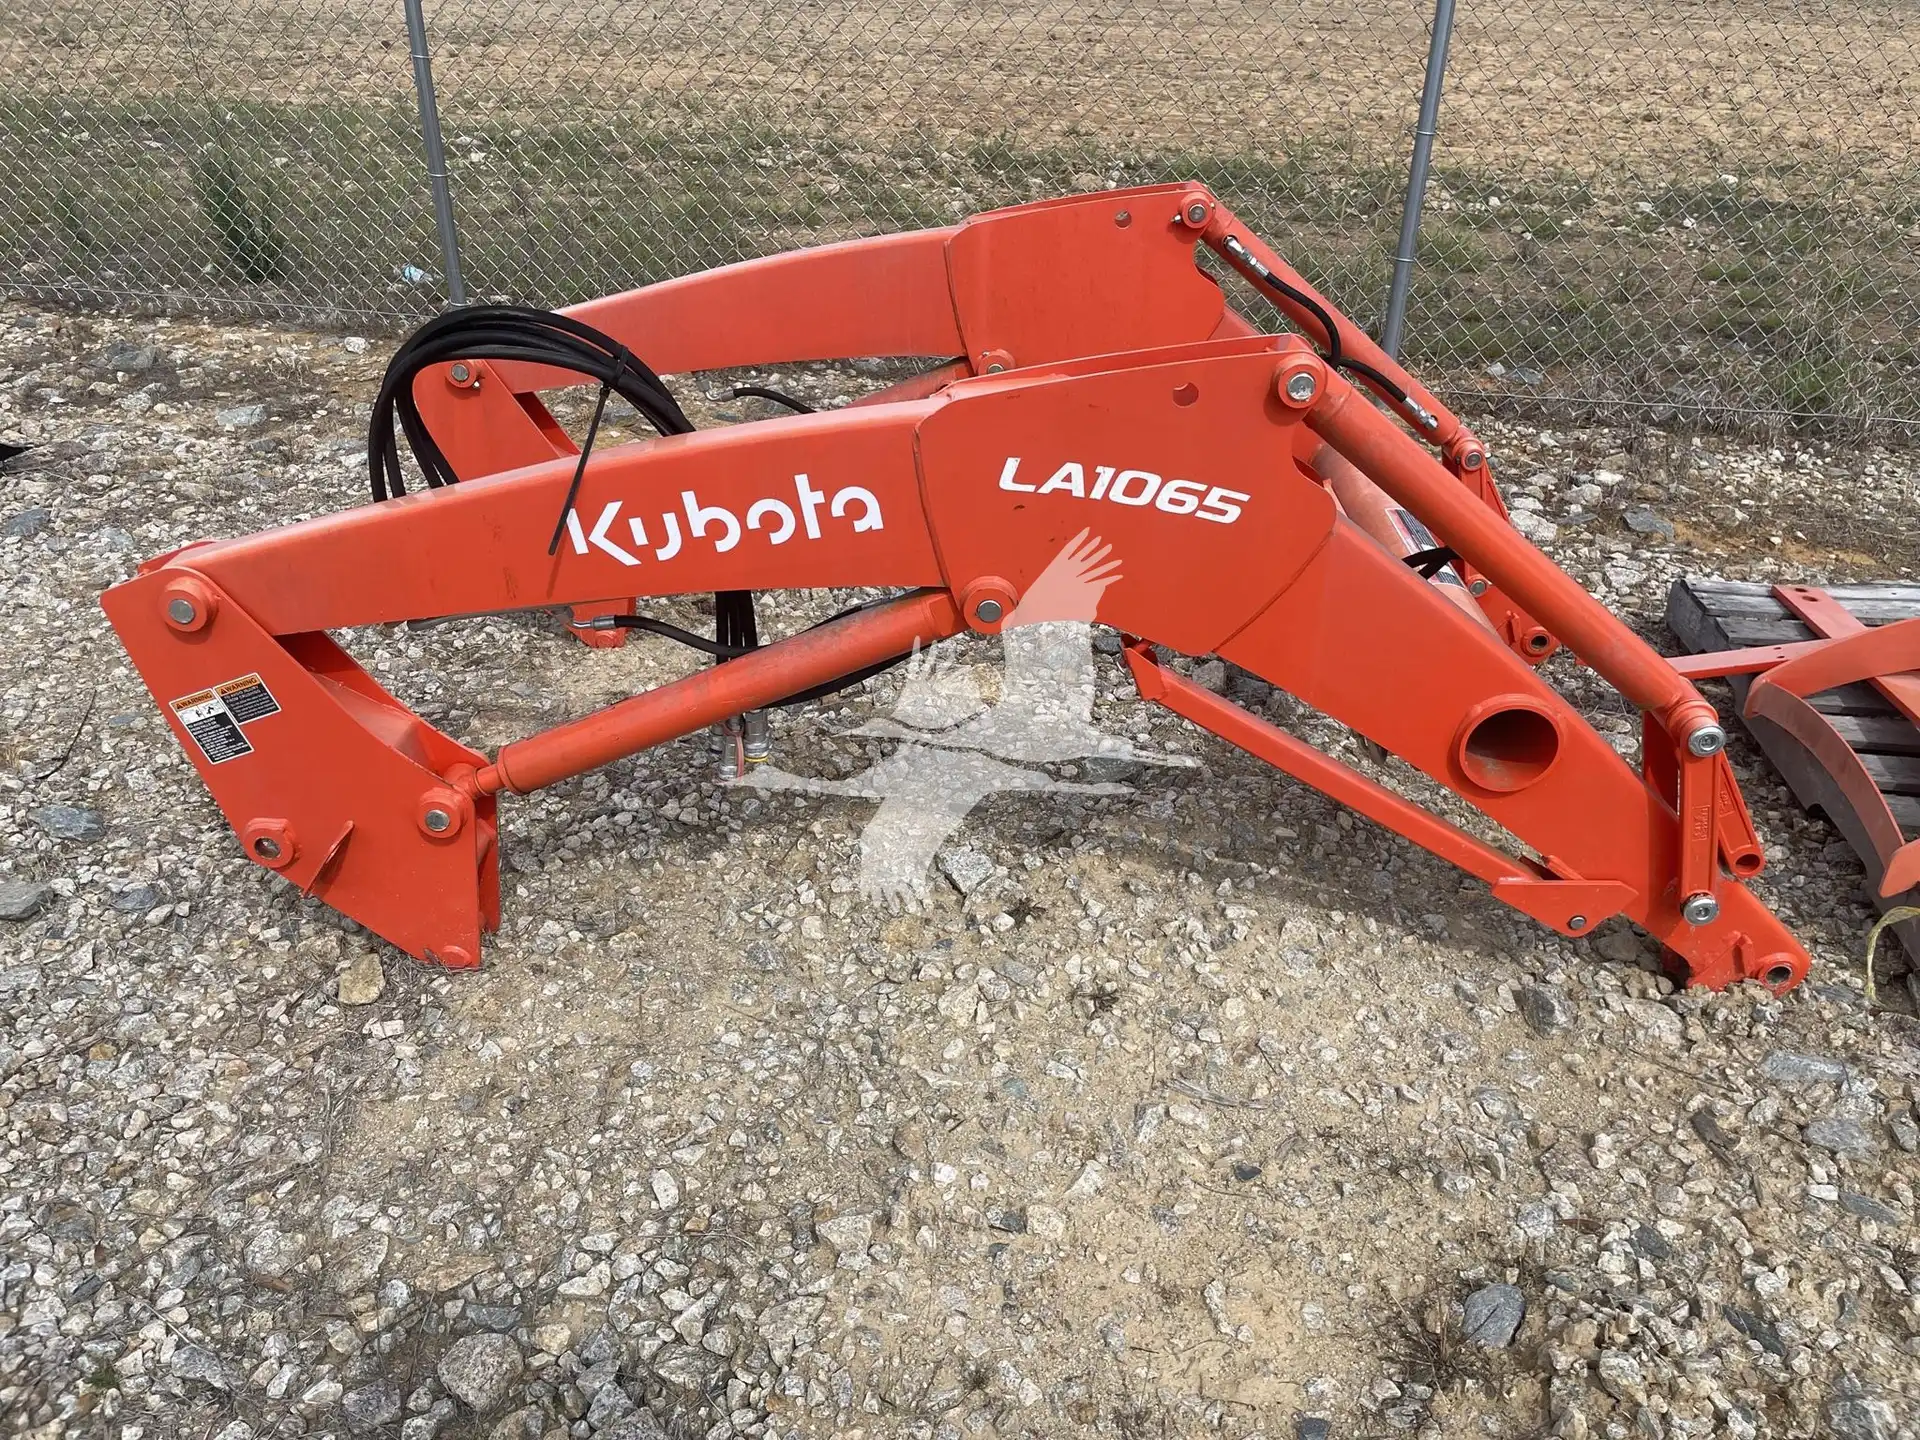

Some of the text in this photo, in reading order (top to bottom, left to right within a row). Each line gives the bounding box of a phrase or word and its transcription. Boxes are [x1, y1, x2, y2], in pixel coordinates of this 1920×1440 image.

[999, 457, 1251, 524] LA1065
[566, 474, 884, 566] Kubota
[179, 692, 212, 707] WARNING
[225, 677, 257, 693] WARNING
